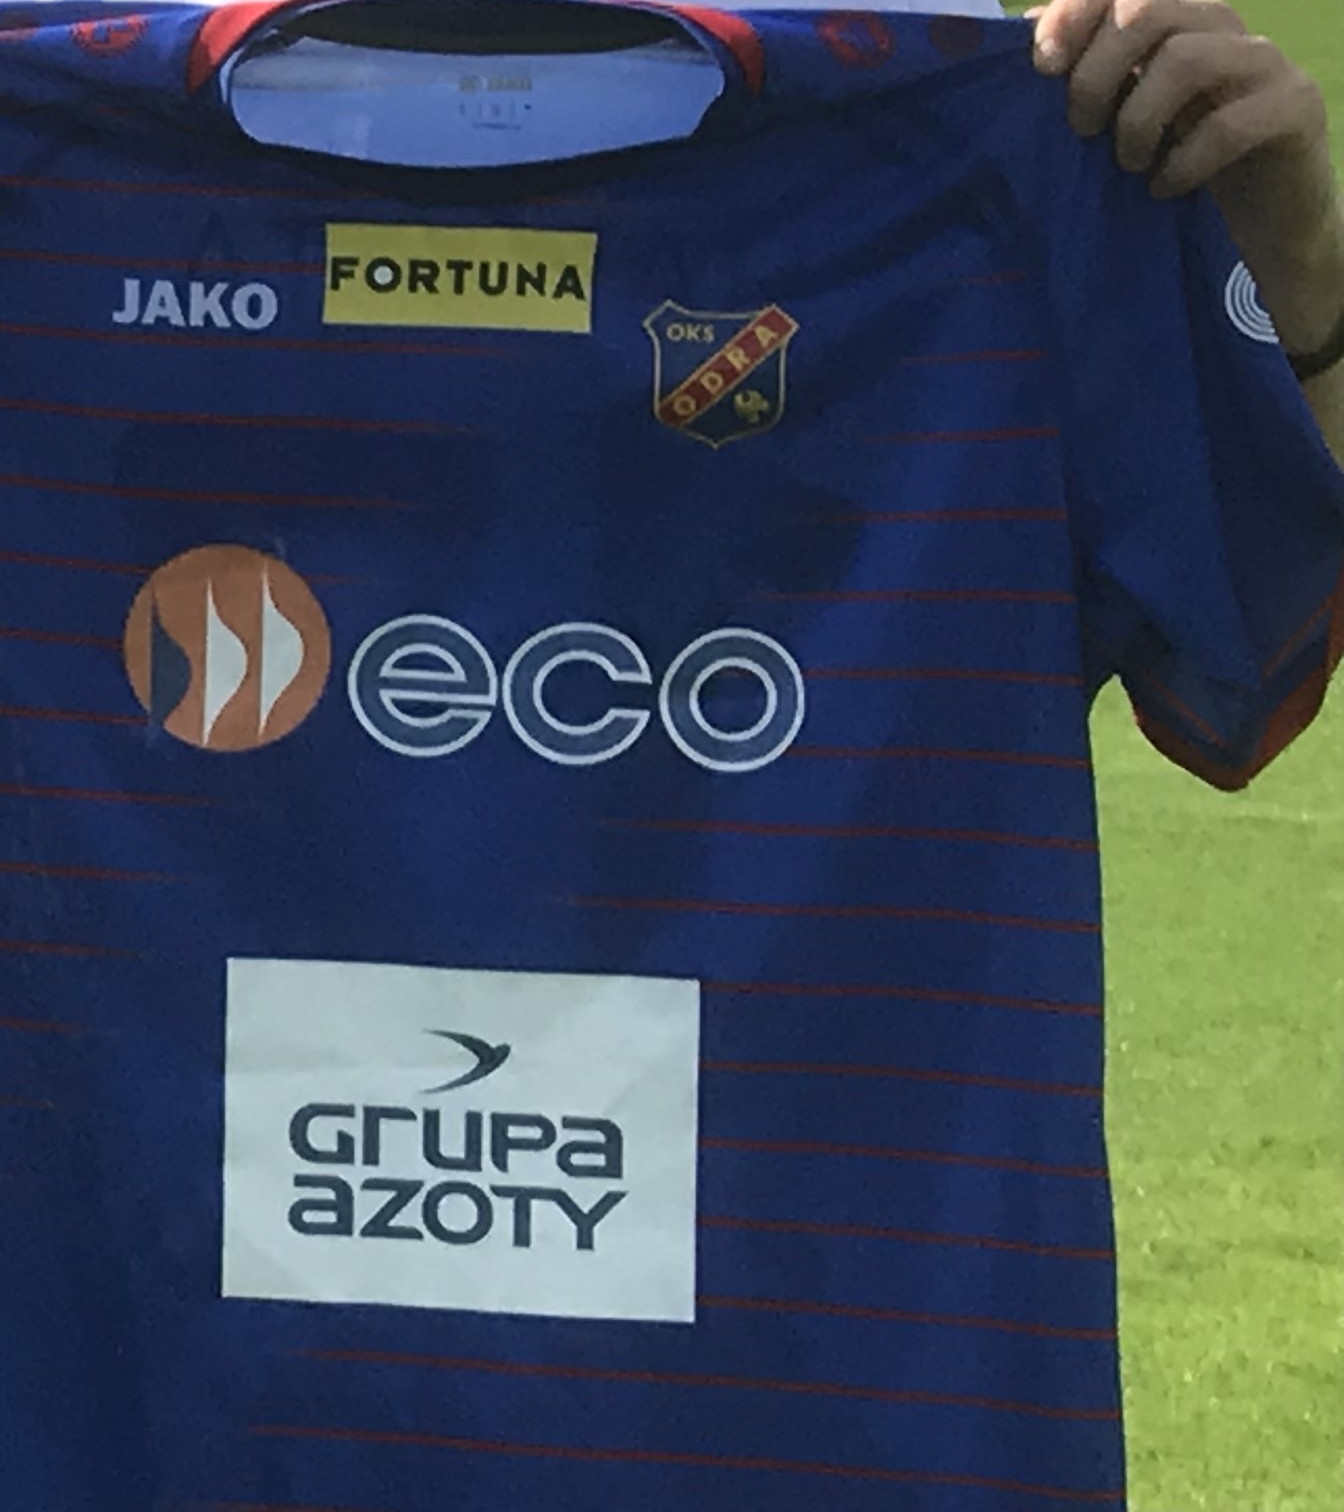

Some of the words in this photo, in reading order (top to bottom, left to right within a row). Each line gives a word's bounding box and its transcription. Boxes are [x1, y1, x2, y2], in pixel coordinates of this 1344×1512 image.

[112, 278, 278, 330] JAKO
[329, 256, 587, 301] FORTUNA
[666, 323, 715, 344] OKS
[673, 325, 778, 416] ODRA
[347, 614, 805, 772] eco
